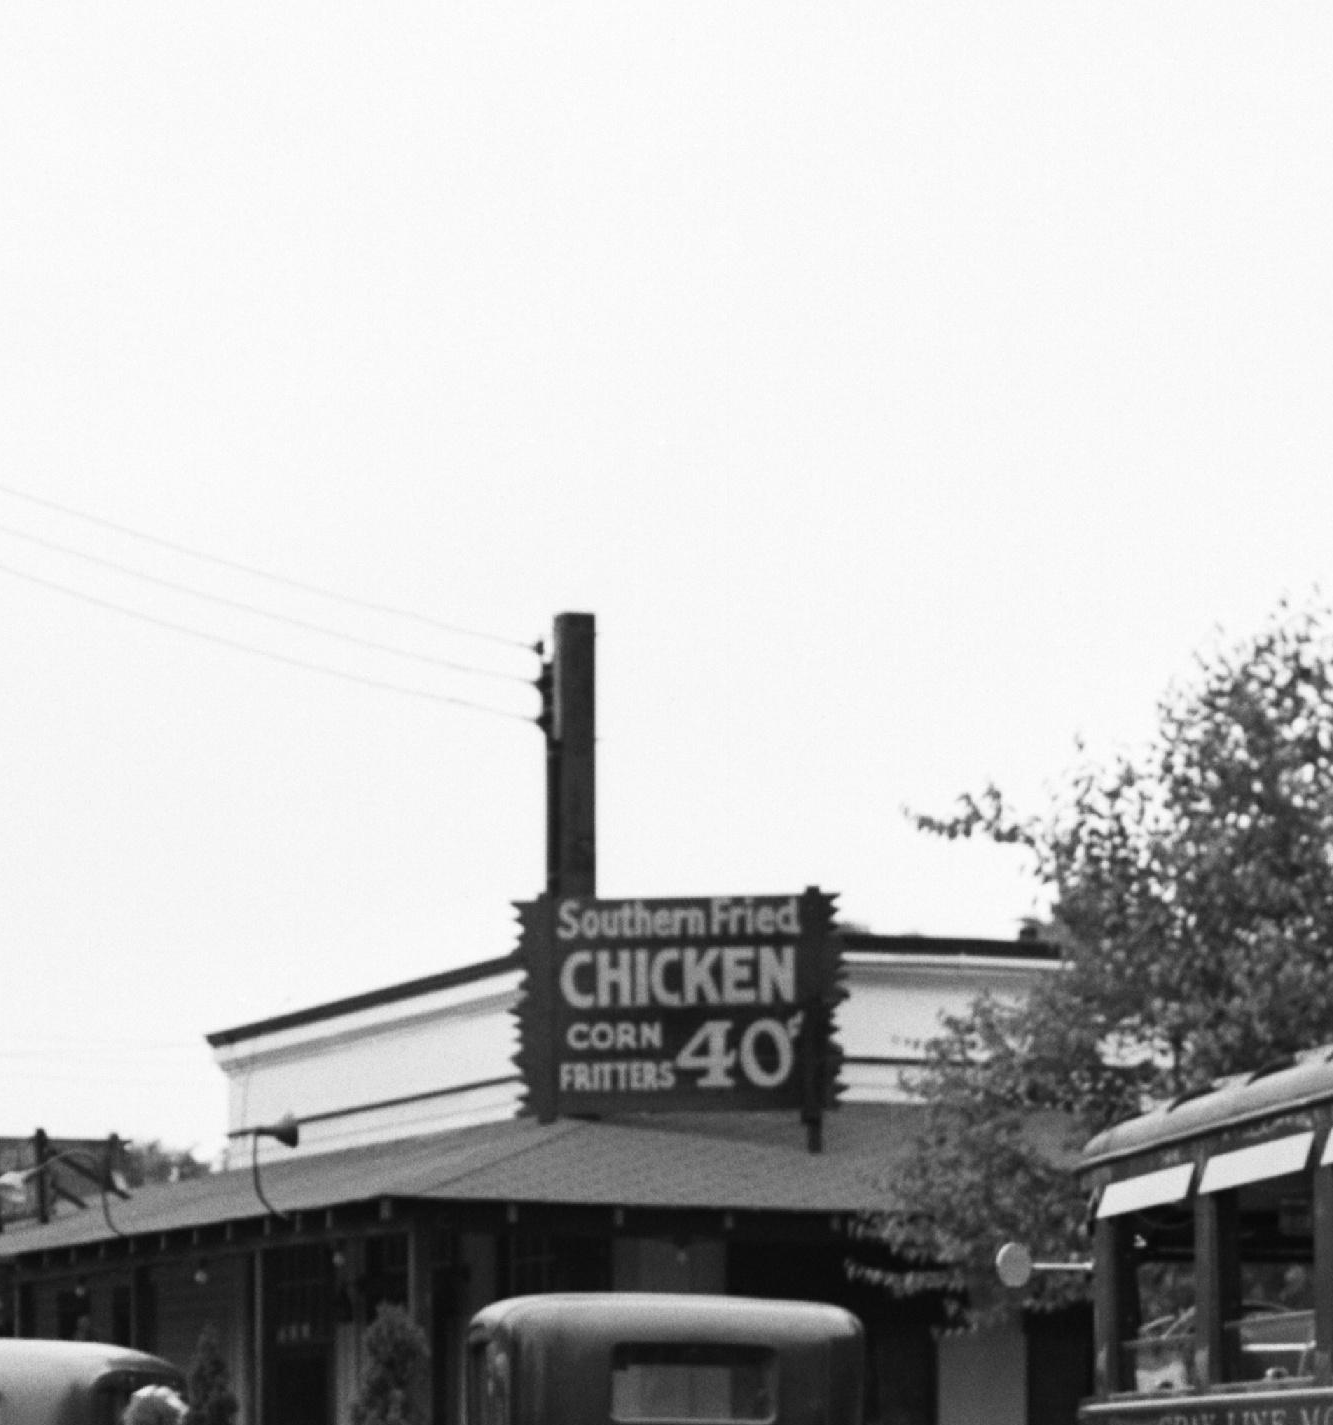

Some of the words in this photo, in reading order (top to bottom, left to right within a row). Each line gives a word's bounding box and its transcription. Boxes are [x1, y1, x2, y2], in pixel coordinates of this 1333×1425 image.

[556, 899, 707, 940] Southern
[710, 896, 802, 936] Fried
[559, 946, 796, 1008] CHICKEN
[567, 1022, 663, 1050] CORN
[559, 1060, 677, 1091] FRITTERS
